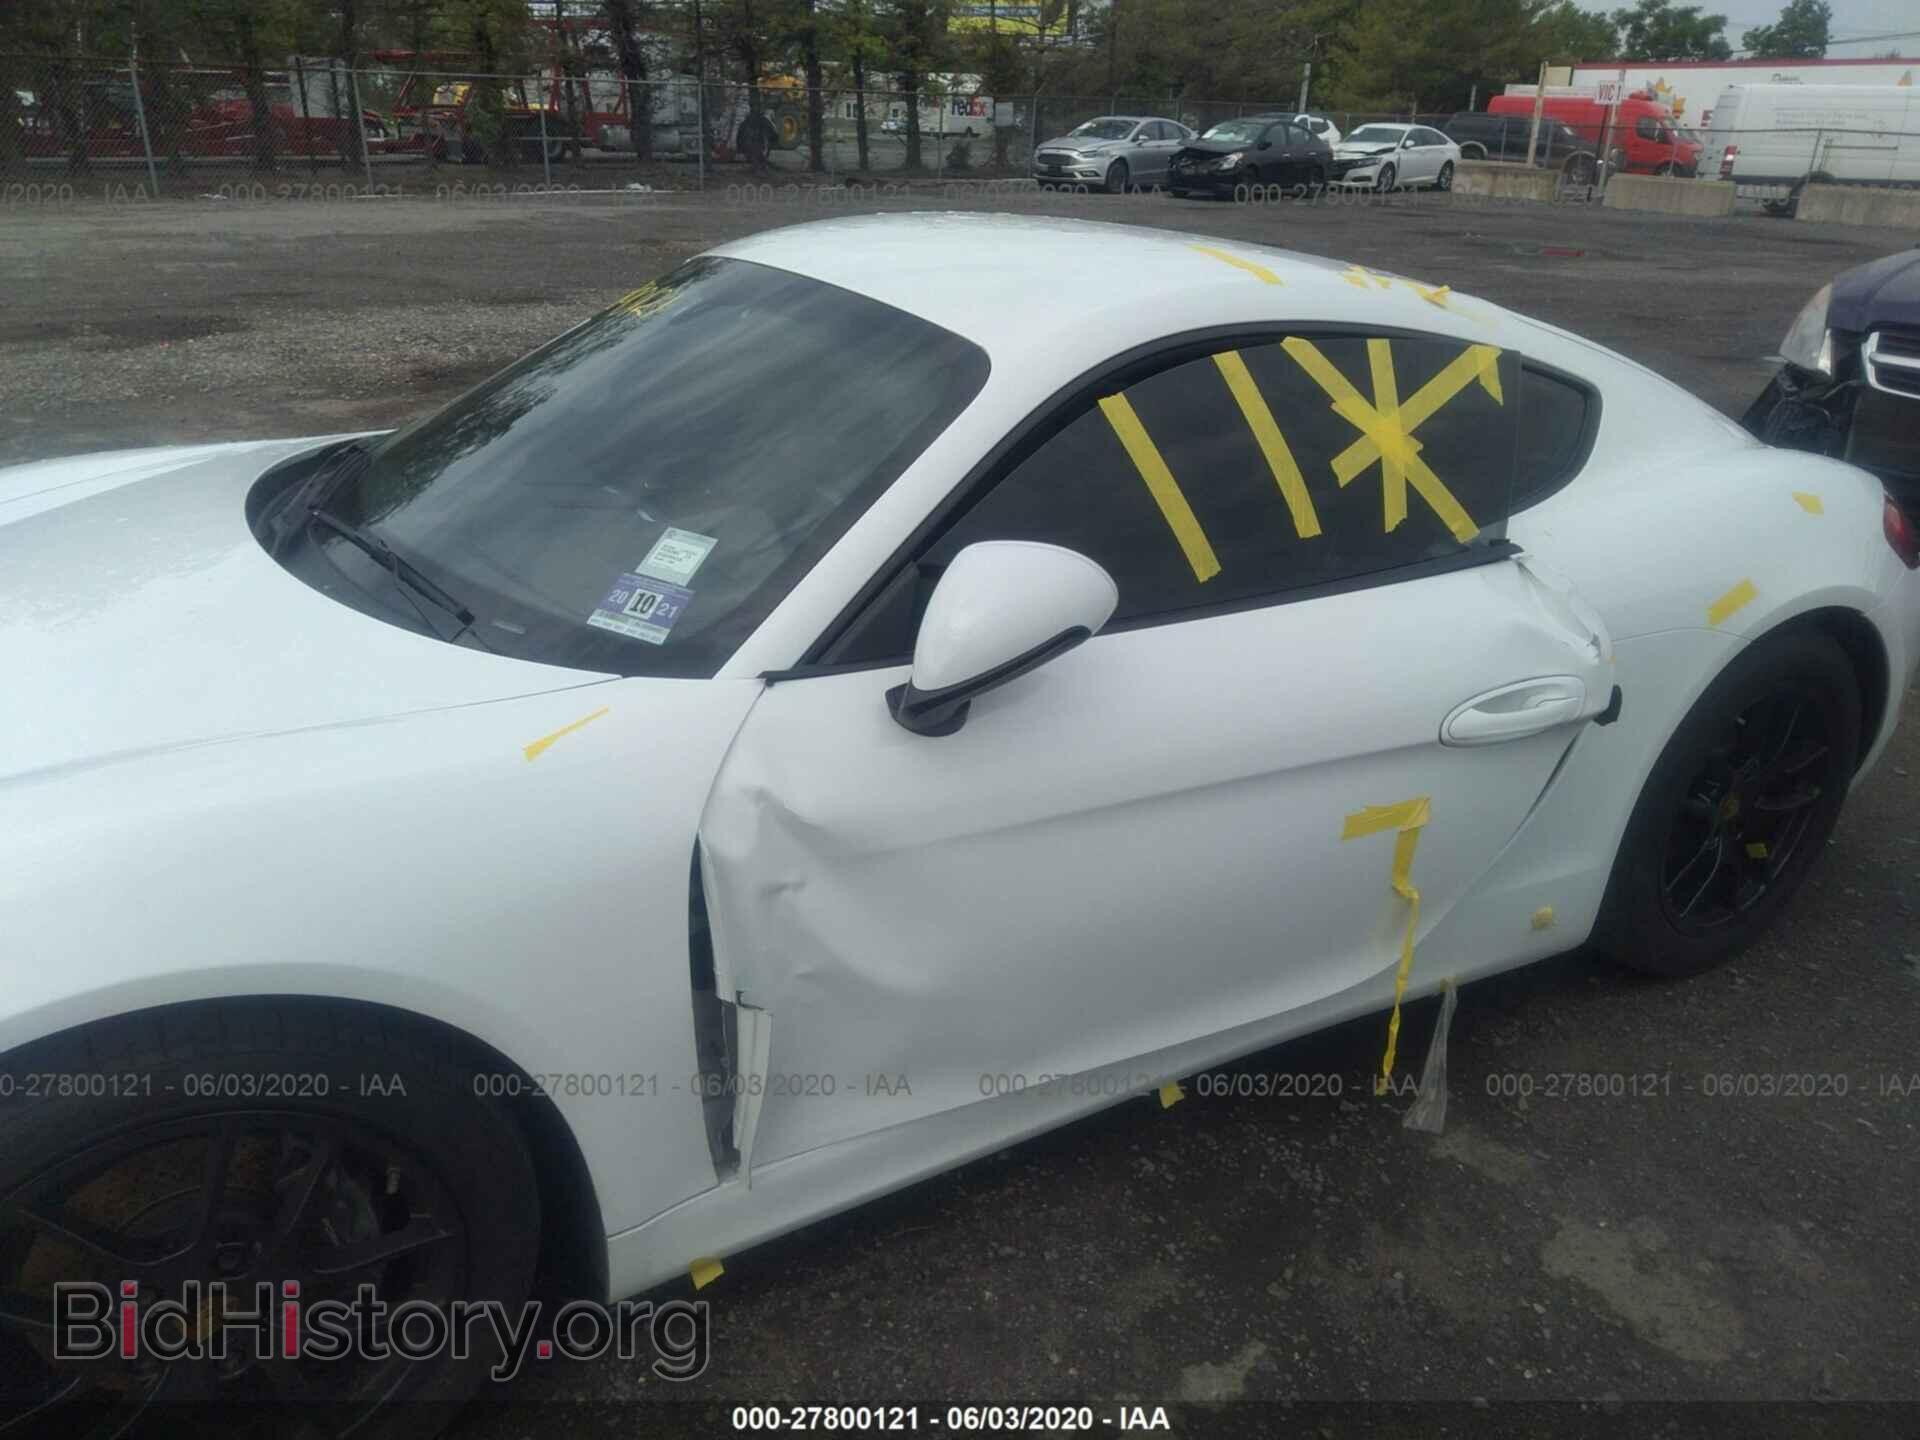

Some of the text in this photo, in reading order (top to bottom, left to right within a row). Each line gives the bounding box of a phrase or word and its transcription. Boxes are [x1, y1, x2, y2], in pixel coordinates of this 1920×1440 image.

[608, 589, 678, 619] 20 10 21
